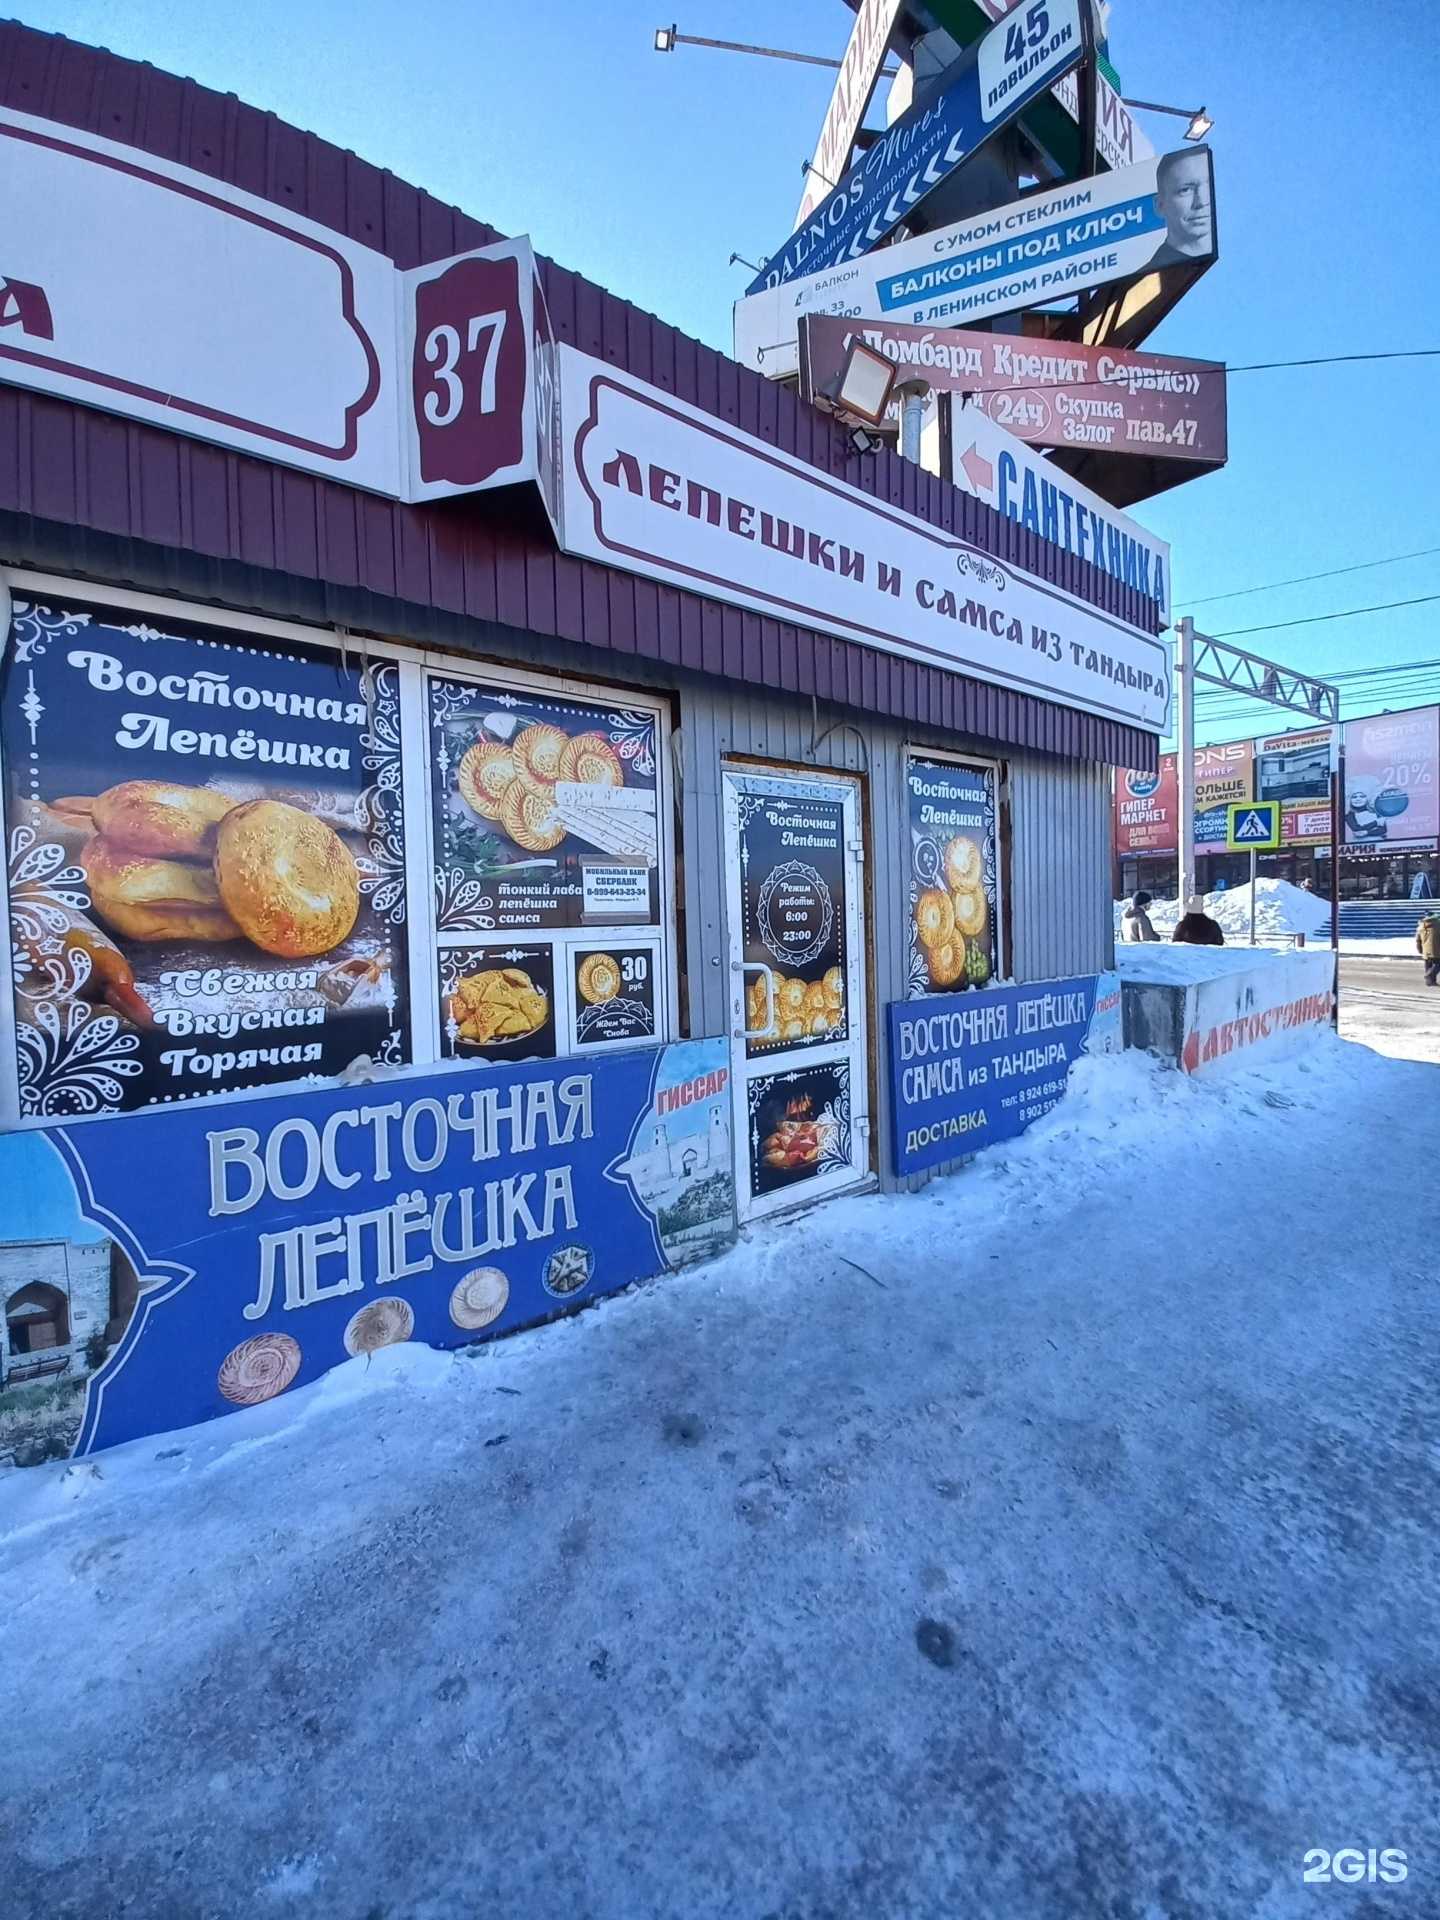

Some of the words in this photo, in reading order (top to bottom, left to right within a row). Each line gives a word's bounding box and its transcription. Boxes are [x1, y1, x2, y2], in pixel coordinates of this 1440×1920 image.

[1003, 0, 1050, 64] 45
[987, 23, 1073, 109] павильон
[866, 96, 946, 180] Mores
[801, 222, 850, 278] осточные
[854, 123, 948, 224] морепродукты
[934, 240, 944, 253] С
[950, 221, 1000, 249] УМОМ
[1005, 191, 1091, 229] СТЕКЛИМ
[891, 253, 1002, 299] БАЛКОНЫ
[1008, 234, 1061, 263] ПОД
[1067, 206, 1143, 246] КЛЮЧ
[816, 270, 859, 291] БАЛКОН
[914, 310, 923, 324] В
[928, 277, 1037, 320] ЛЕНИНСКОМ
[1041, 253, 1118, 287] РАЙОНЕ
[831, 300, 845, 312] 33
[424, 309, 507, 427] 37
[993, 344, 1088, 384] Кредит
[1097, 357, 1201, 396] Сервис»
[996, 396, 1045, 428] 24ч
[1055, 392, 1124, 420] Скупка
[1063, 418, 1115, 444] Залог
[1126, 420, 1198, 447] пав.47
[999, 449, 1166, 613] САНТЕХНИКА
[602, 449, 865, 582] ЛЕПЕШКИ
[878, 561, 902, 598] И
[916, 578, 1024, 645] САМСА
[1032, 626, 1062, 662] ИЗ
[1070, 640, 1166, 700] ТАНДЫРА
[67, 649, 368, 727] Восточная
[115, 712, 352, 770] Лепёшка
[1194, 744, 1245, 766] DNS
[1196, 780, 1245, 796] ОЛЬШЕ
[1383, 762, 1432, 788] 20%
[908, 776, 987, 803] Восточная
[920, 804, 982, 827] Лепёшка
[1120, 799, 1156, 813] ГИПЕР
[1120, 808, 1167, 825] МАРКЕТ
[766, 811, 836, 831] Восточная
[781, 831, 837, 848] Лепёшка
[498, 882, 550, 896] тонкий
[552, 883, 583, 896] лава
[595, 878, 638, 886] СБЕРБАНК
[780, 882, 811, 893] Режим
[499, 898, 557, 910] лепёшка
[778, 896, 815, 909] работы:
[499, 913, 541, 924] самса
[785, 911, 808, 922] 6:00
[782, 930, 811, 942] 23:00
[621, 956, 647, 981] 30
[159, 968, 319, 997] Свежая
[153, 1005, 326, 1039] Вкусная
[900, 1004, 1008, 1061] ВОСТОЧНАЯ
[1015, 992, 1087, 1036] ЛЕПЁШКА
[159, 1042, 324, 1079] Горячая
[902, 1057, 963, 1105] САМСА
[992, 1042, 1067, 1080] ТАНДЫРА
[657, 1068, 729, 1116] ГИССАР
[1019, 1090, 1025, 1103] 8
[1026, 1086, 1042, 1100] 924
[1026, 1103, 1042, 1119] 902
[905, 1109, 988, 1154] ДОСТАВКА
[206, 1074, 595, 1218] ВОСТОЧНАЯ
[243, 1165, 579, 1320] ЛЕПЁШКА
